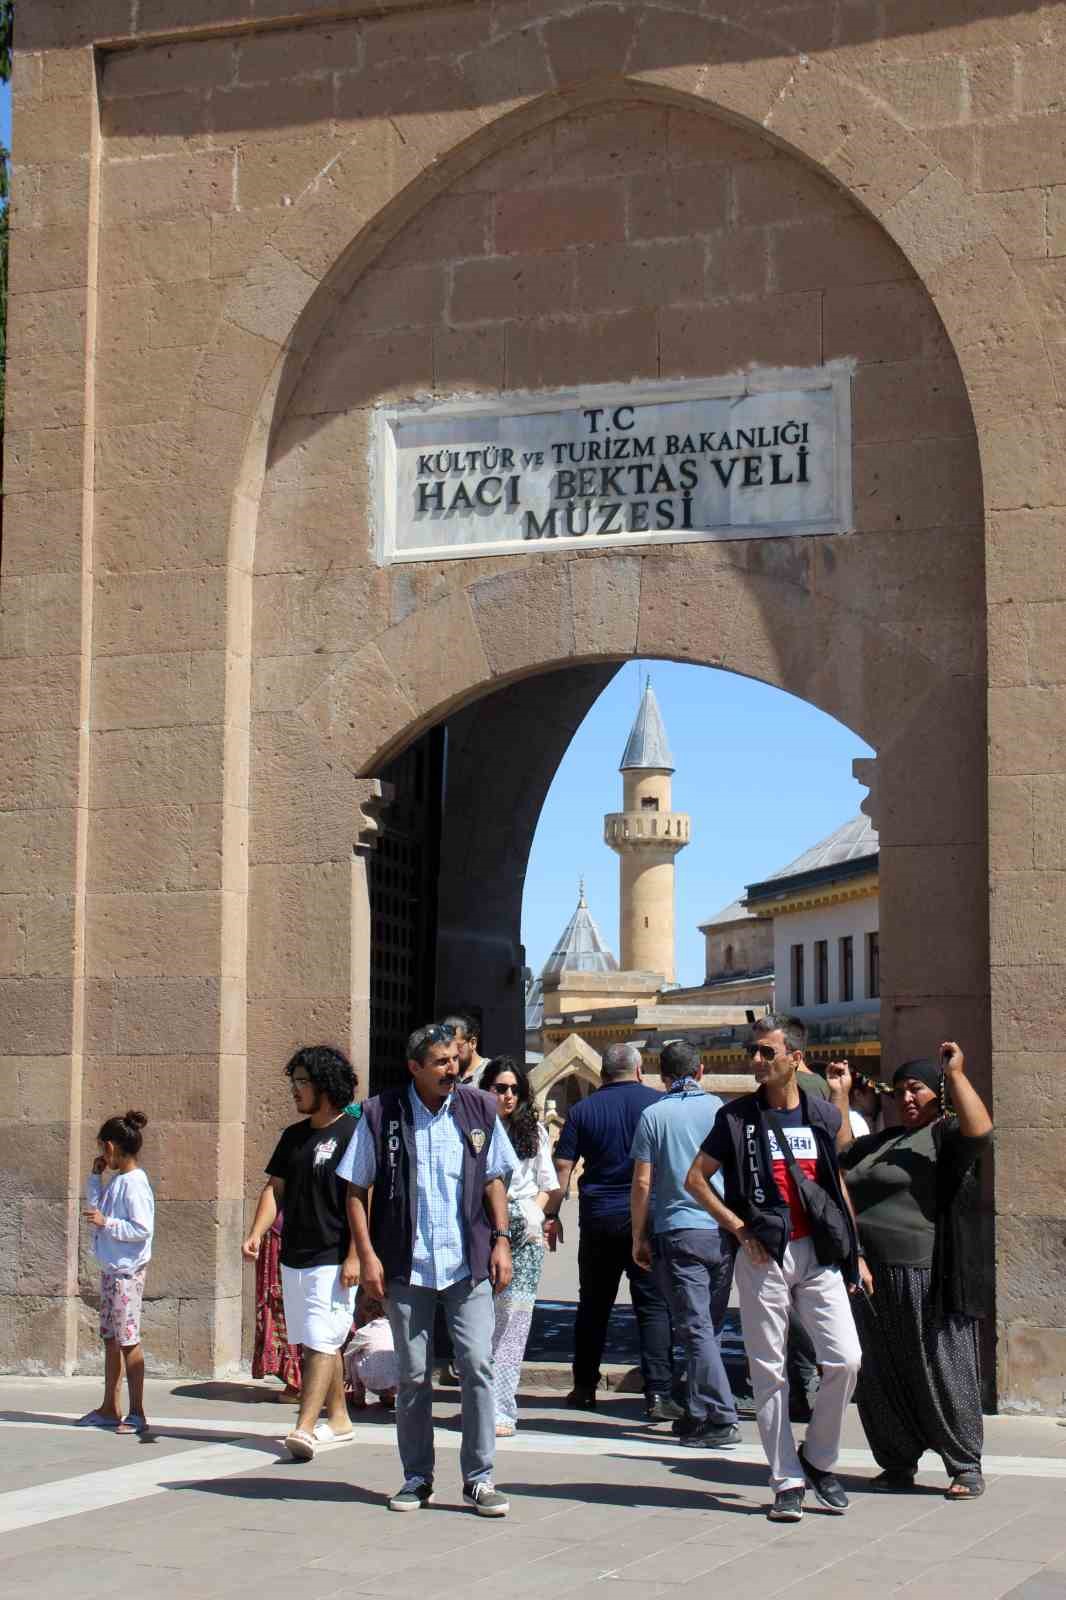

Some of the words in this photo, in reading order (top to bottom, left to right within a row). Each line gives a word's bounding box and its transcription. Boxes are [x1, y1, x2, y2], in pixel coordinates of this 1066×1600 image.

[418, 446, 515, 474] KÜLTÜR
[523, 451, 545, 466] VE
[552, 437, 656, 463] TURİZM
[666, 420, 810, 456] BAKANLIĞI
[584, 406, 635, 434] T.C
[417, 475, 521, 512] HACI
[710, 445, 810, 489] VELİ
[524, 490, 694, 540] MÜZESİ
[746, 1124, 766, 1204] POLIS
